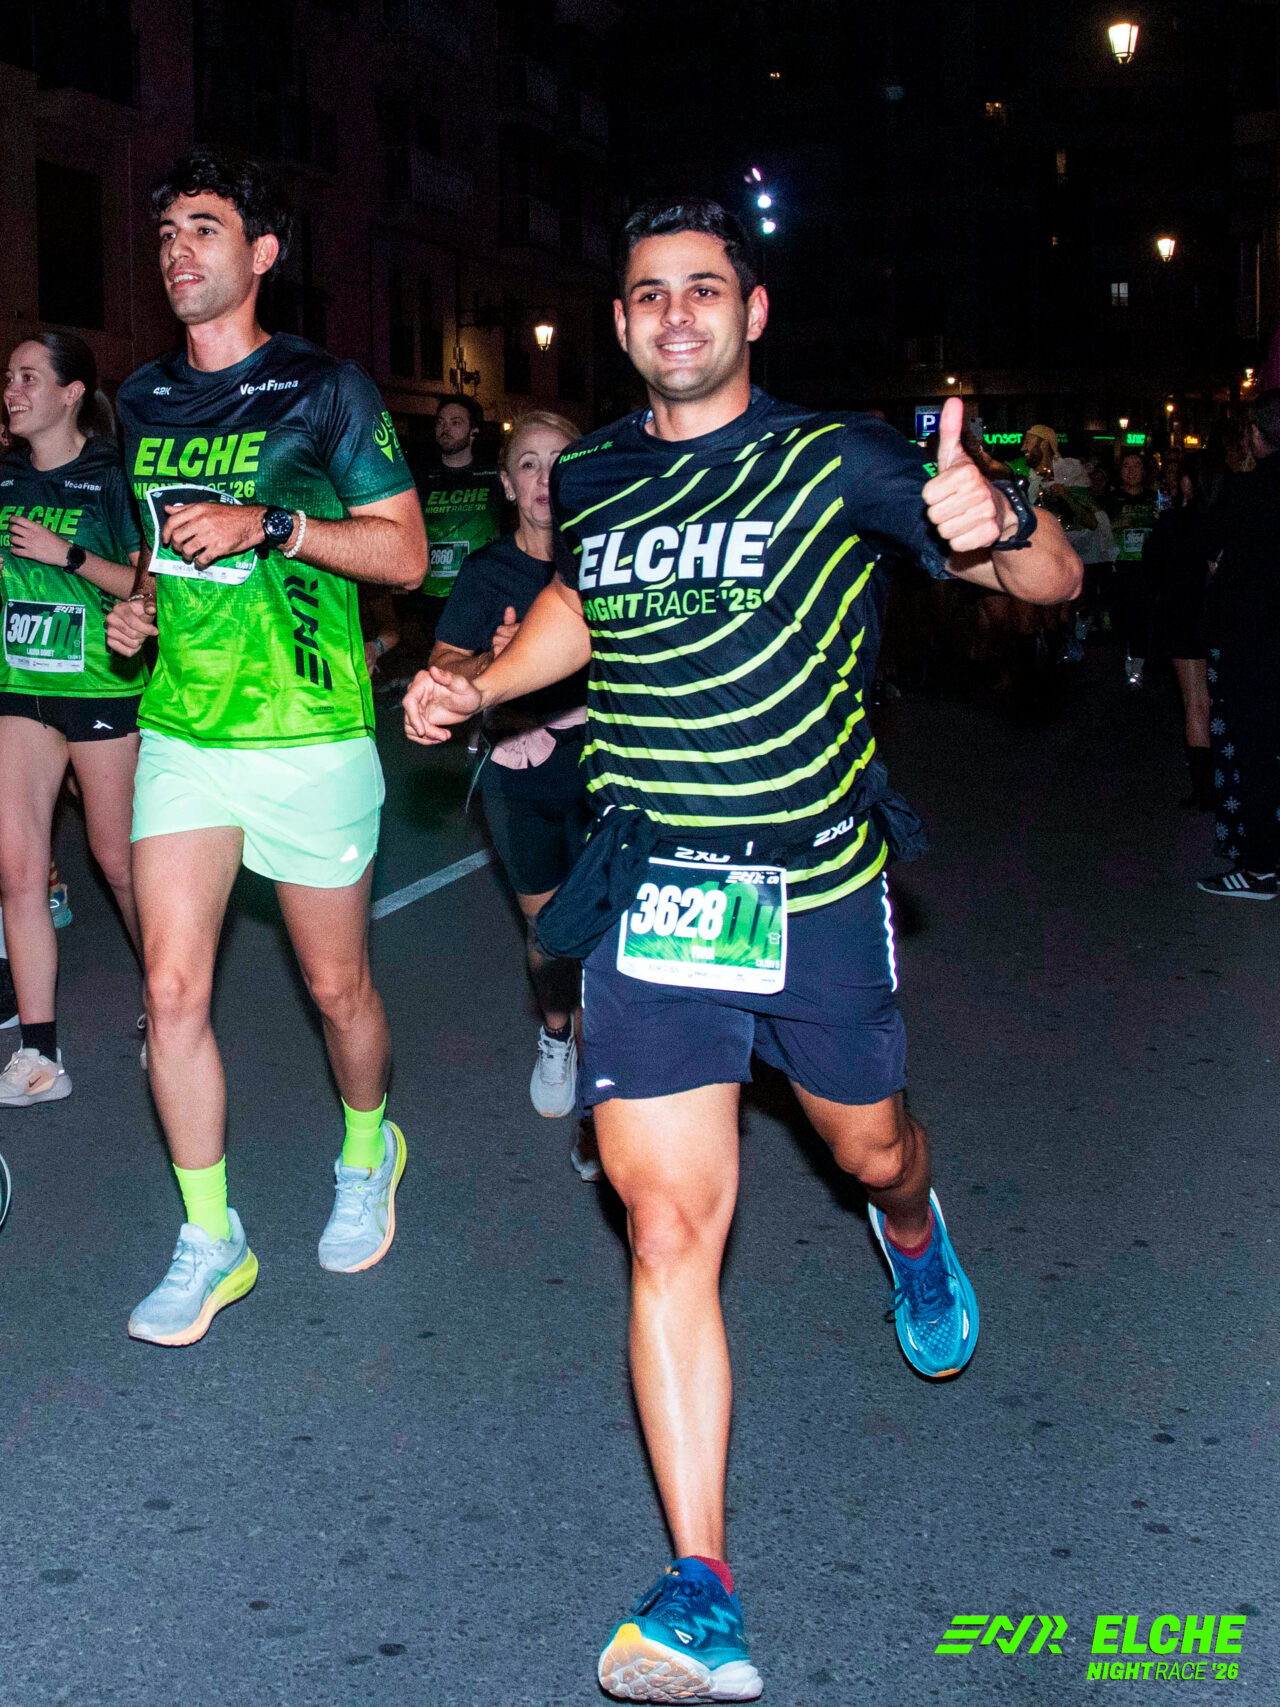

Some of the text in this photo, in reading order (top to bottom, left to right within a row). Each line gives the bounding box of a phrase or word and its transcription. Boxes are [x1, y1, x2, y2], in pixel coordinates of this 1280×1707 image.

[923, 414, 936, 431] P
[133, 431, 268, 477] ELCHE
[229, 481, 255, 498] '26
[427, 488, 490, 506] ELCHE
[579, 521, 775, 591] ELCHE
[721, 588, 762, 613] '25
[7, 613, 54, 646] 3071
[813, 816, 854, 848] 2XU
[674, 847, 730, 863] 2XU
[630, 882, 728, 941] 3628
